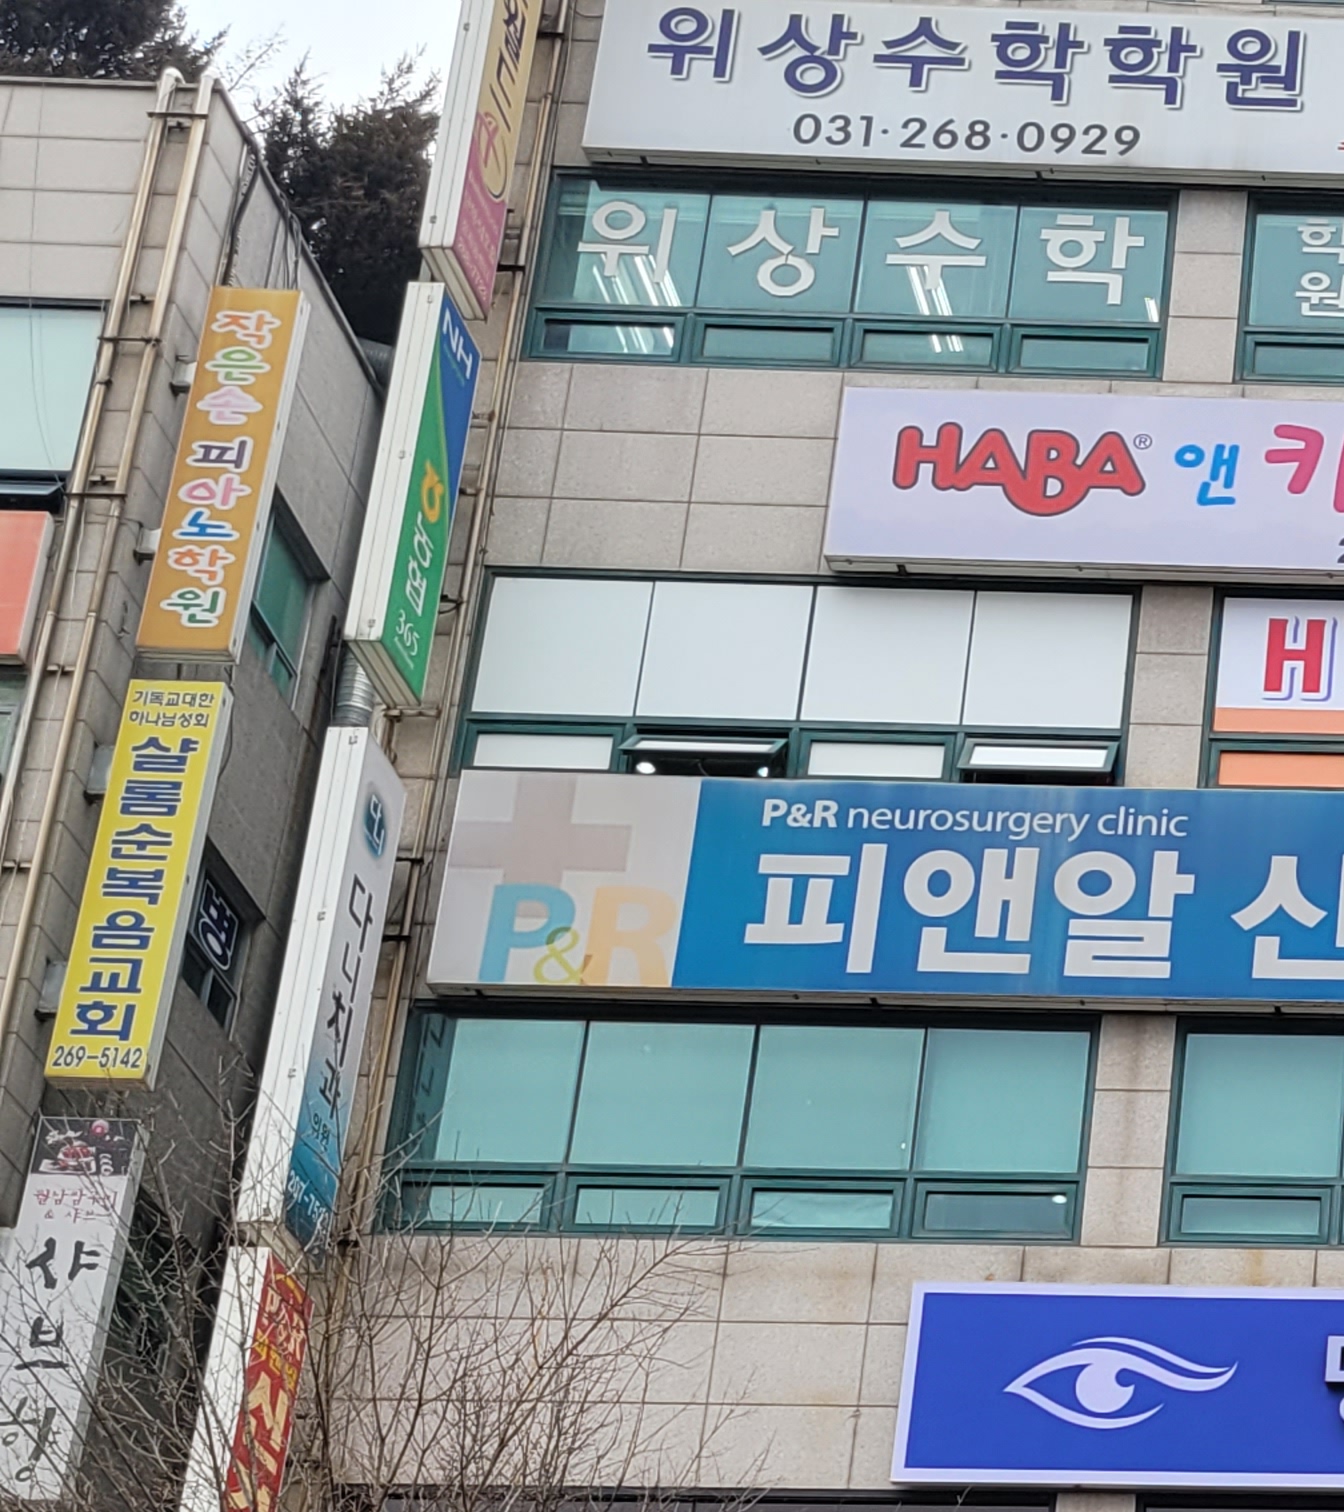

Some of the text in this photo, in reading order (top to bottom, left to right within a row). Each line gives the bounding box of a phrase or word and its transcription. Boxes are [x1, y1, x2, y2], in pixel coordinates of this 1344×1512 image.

[647, 6, 1311, 112] 위상수학학원
[576, 199, 1146, 306] 위상수학
[892, 421, 1147, 518] HABA
[1173, 442, 1241, 508] 앤
[129, 709, 210, 729] 하나님성회
[133, 688, 215, 709] 기독교대한
[761, 799, 1190, 842] P&R neurosurgery clinic
[477, 882, 679, 988] P&R
[742, 842, 1197, 980] 피앤알
[51, 1043, 145, 1070] 269-5142
